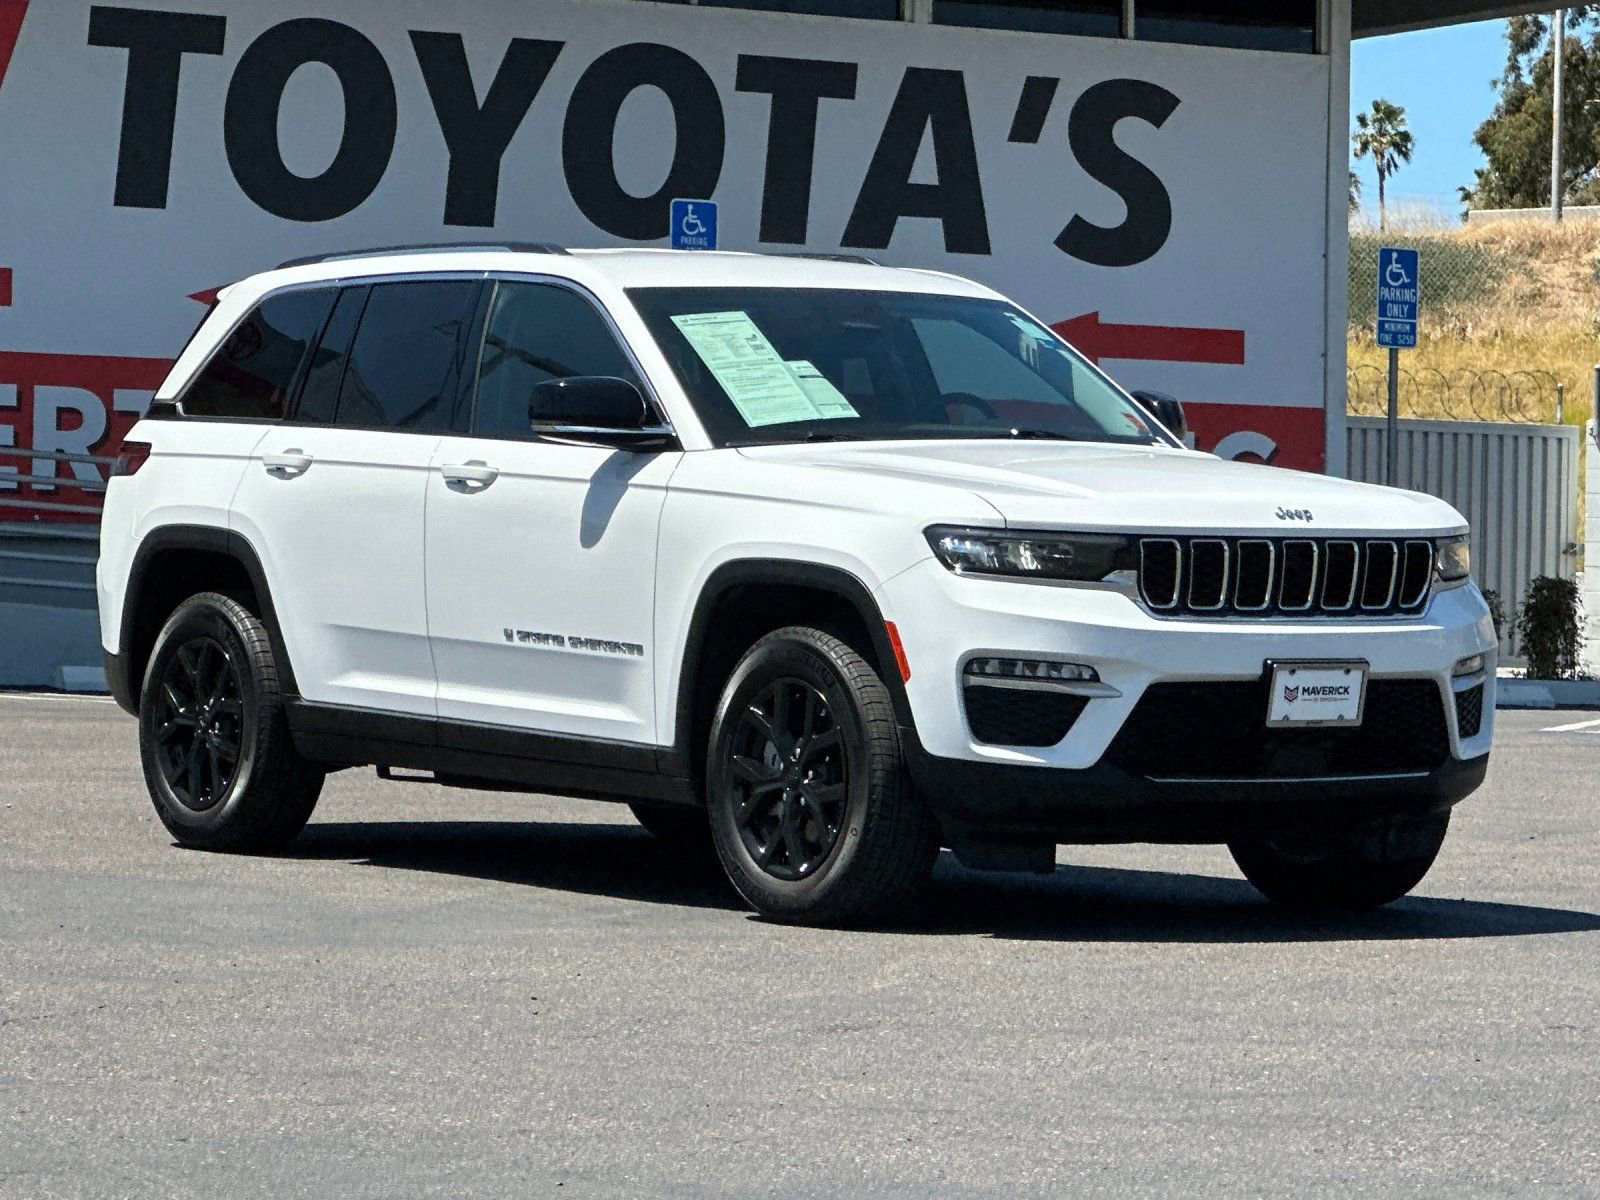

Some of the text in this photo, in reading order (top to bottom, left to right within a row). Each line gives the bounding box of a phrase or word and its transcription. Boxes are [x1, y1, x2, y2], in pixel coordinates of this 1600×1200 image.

[87, 5, 1181, 268] TOYOTA'S
[680, 236, 708, 247] PARKING
[1380, 286, 1416, 303] PARKING
[1386, 303, 1409, 318] ONLY
[1384, 322, 1411, 333] MINIMUM
[1379, 333, 1393, 344] FINE
[1275, 506, 1314, 523] Jeep
[1302, 686, 1351, 696] MAVERICK
